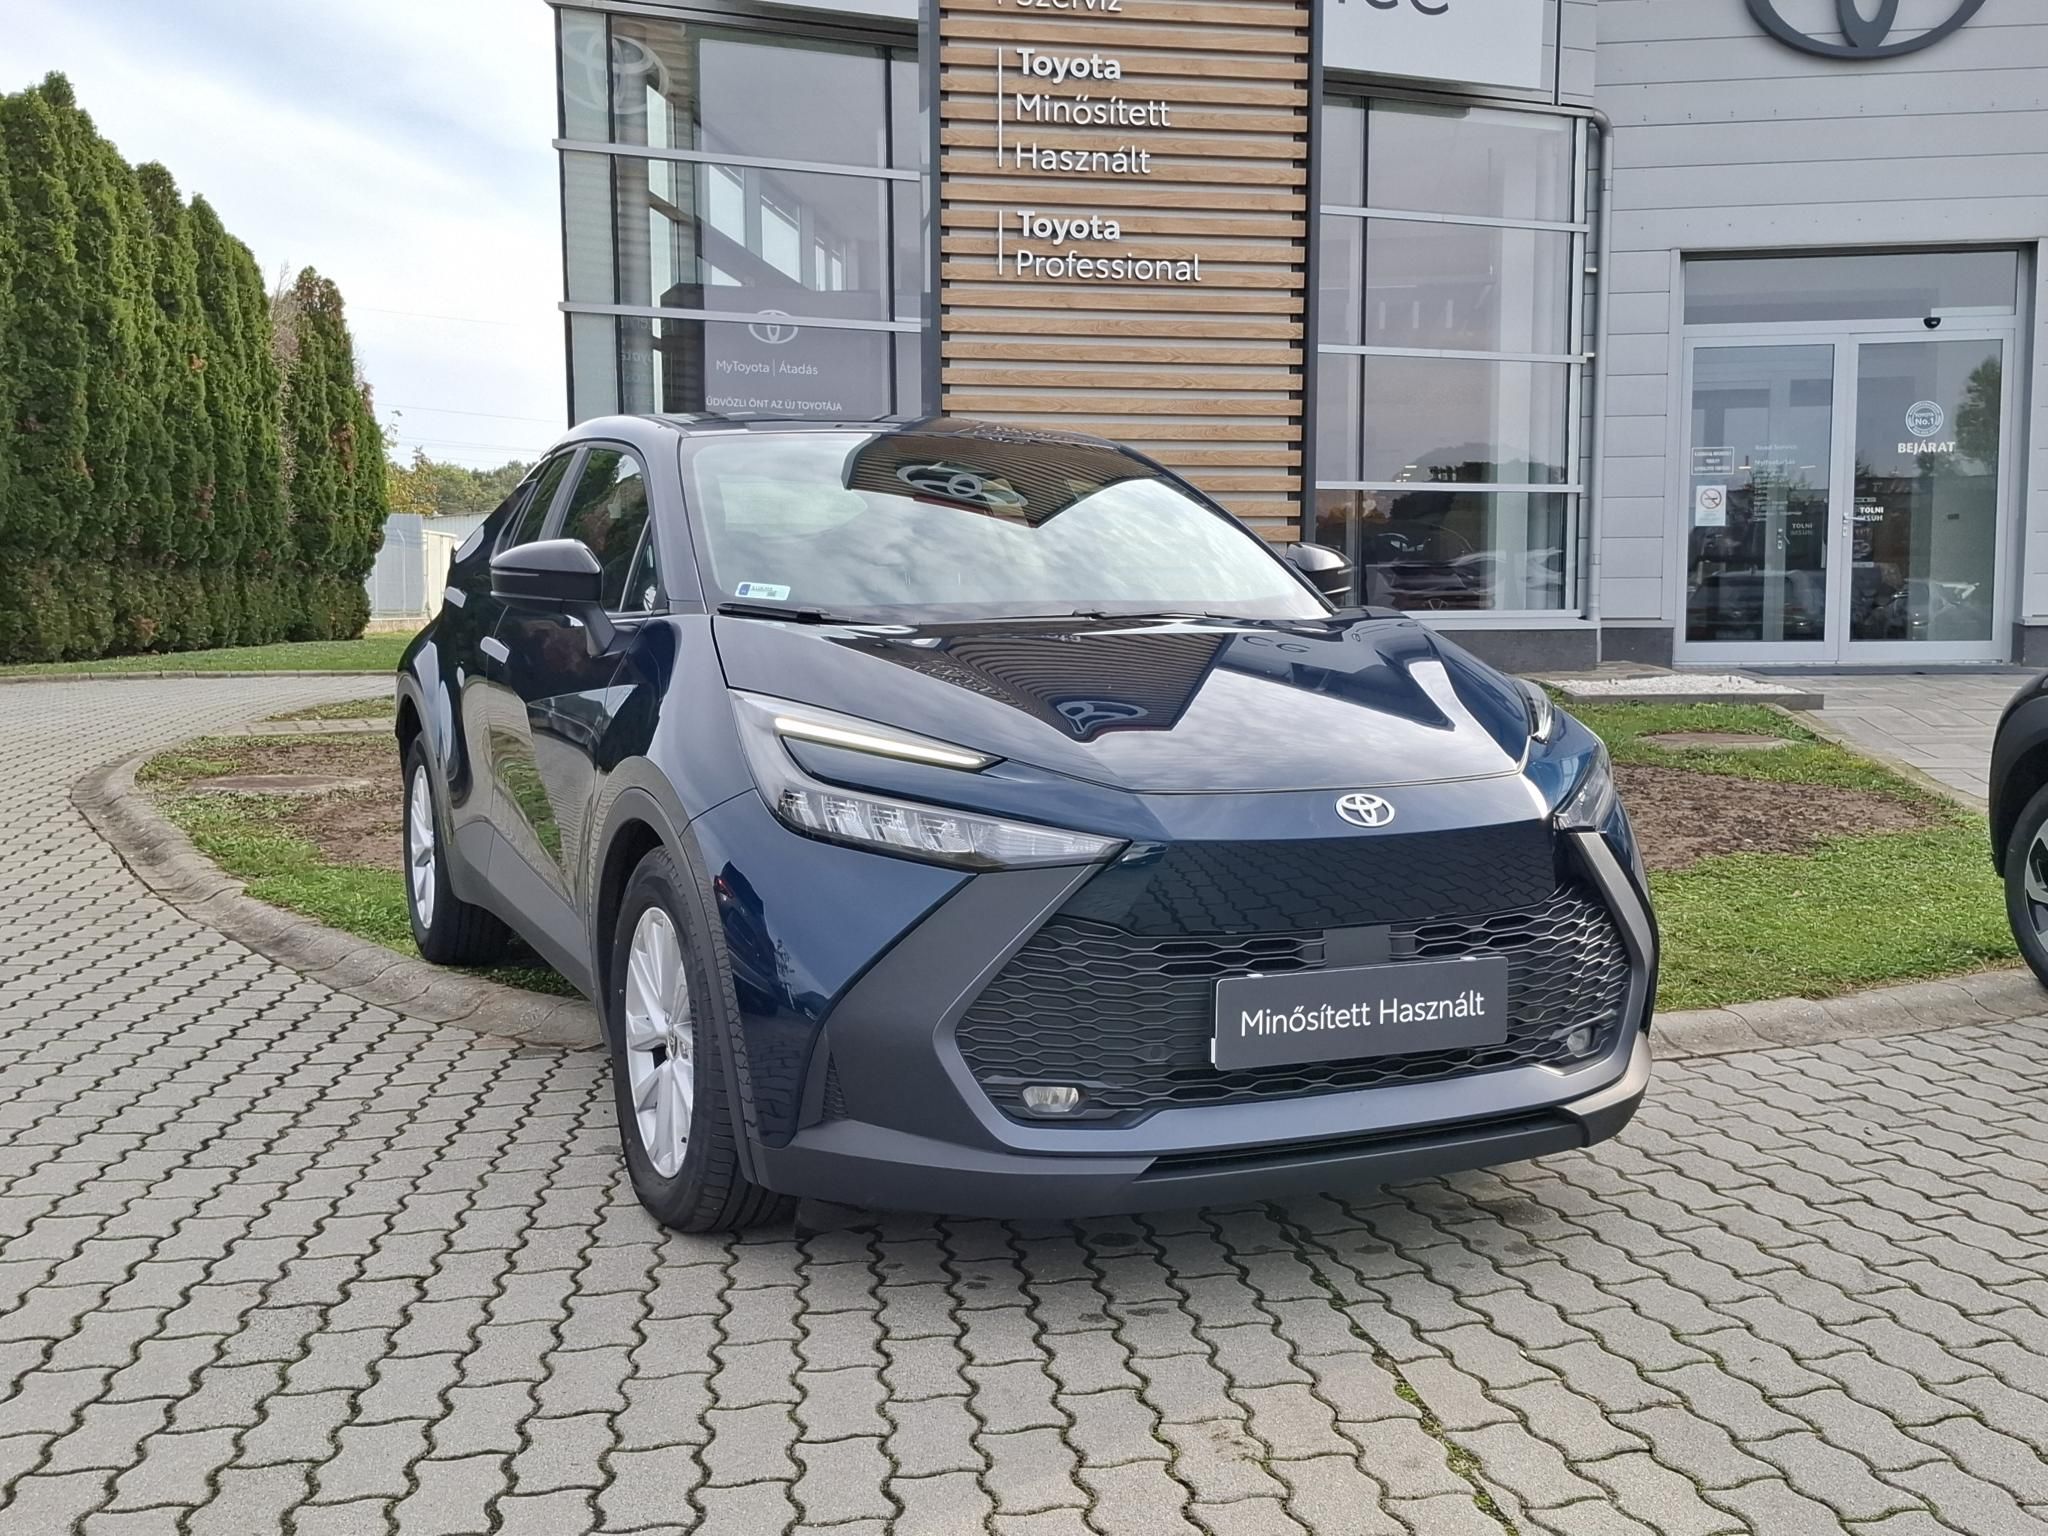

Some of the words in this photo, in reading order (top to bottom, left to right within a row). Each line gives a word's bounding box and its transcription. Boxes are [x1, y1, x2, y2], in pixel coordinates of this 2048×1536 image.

[1016, 47, 1121, 84] Toyota
[1016, 92, 1171, 127] Minősített
[1016, 142, 1151, 174] Használt
[1016, 210, 1120, 246] Toyota
[1016, 249, 1202, 282] Professional
[716, 359, 770, 375] MyToyota
[778, 359, 818, 375] Átadás
[770, 400, 783, 410] AZ
[1914, 417, 1935, 426] No.1
[1897, 439, 1956, 455] BEJÁRAT
[1860, 506, 1884, 514] TOLNI
[1240, 1002, 1371, 1037] Minősített
[1379, 989, 1485, 1025] Használt
